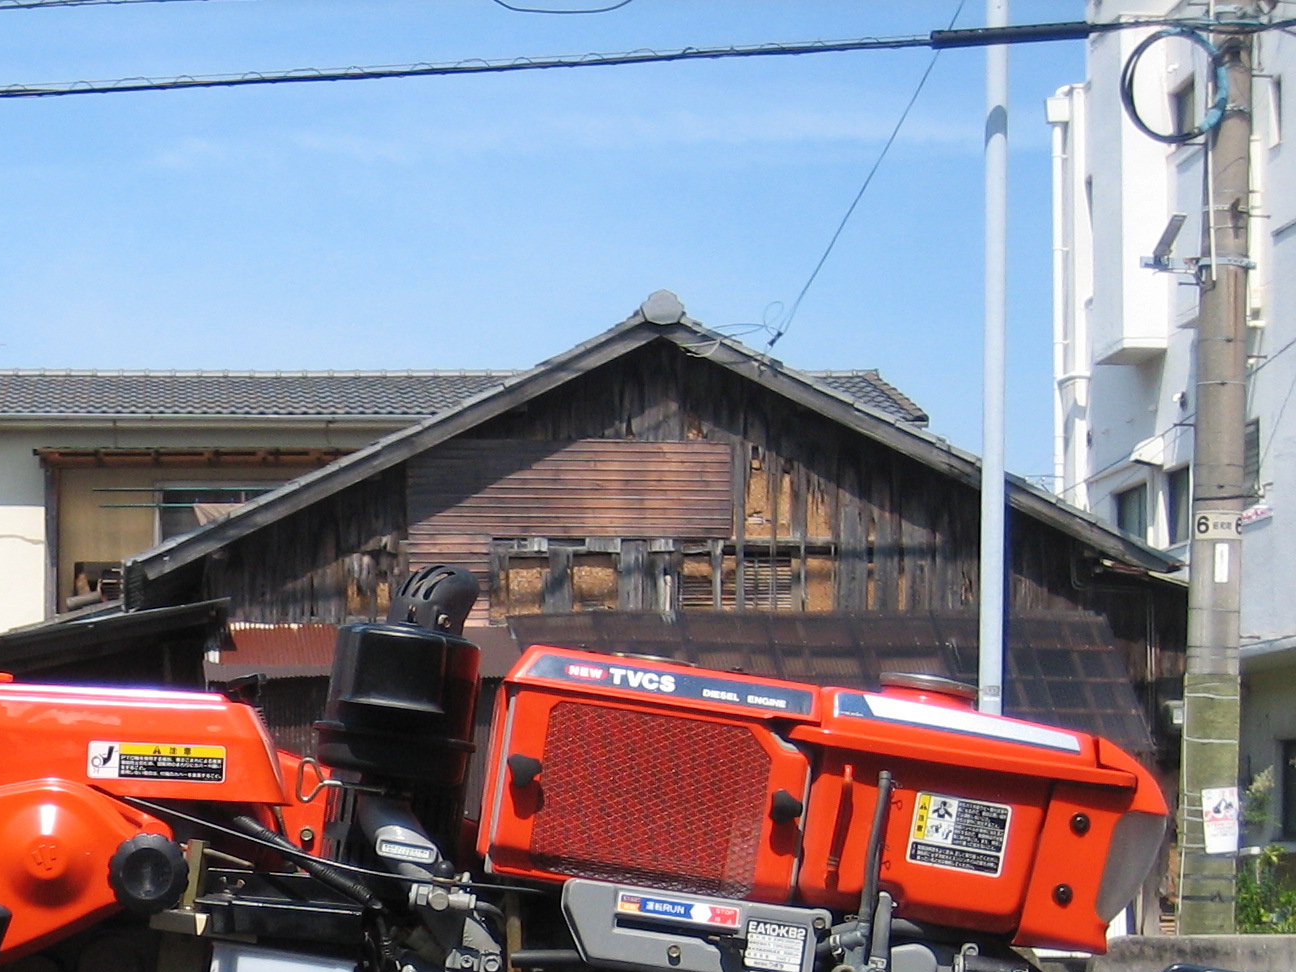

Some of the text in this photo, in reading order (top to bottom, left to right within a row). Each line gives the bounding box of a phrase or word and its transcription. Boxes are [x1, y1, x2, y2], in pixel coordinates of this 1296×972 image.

[1197, 515, 1210, 534] 6
[568, 665, 787, 709] NEW TVCS DIESEL ENGINE
